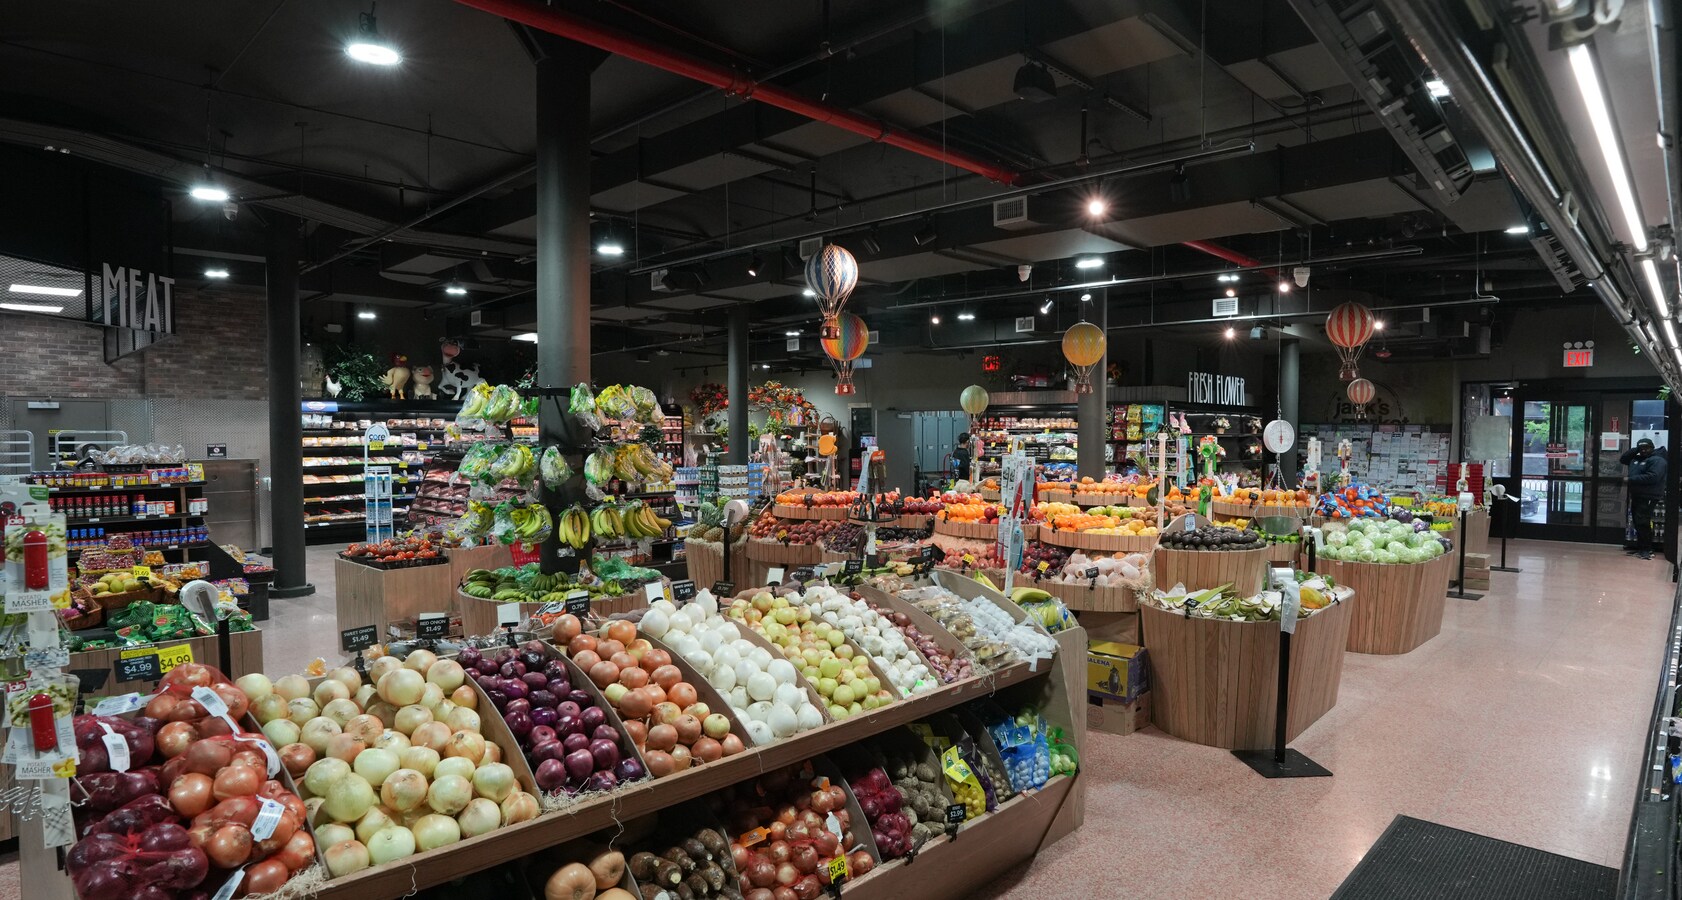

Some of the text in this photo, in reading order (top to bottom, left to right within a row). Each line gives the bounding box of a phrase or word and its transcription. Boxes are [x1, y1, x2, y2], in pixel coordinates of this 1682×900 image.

[102, 262, 176, 334] MEAT
[1567, 351, 1591, 366] EXIT
[1188, 371, 1246, 406] FRESH FLOWER
[1333, 397, 1390, 419] jak's
[12, 599, 48, 607] MASHER
[425, 625, 442, 633] $1.49
[352, 634, 369, 643] $1.49
[124, 663, 152, 674] $4.99
[160, 654, 191, 670] $4.99
[950, 809, 964, 818] $2.99
[829, 861, 845, 876] $1.49
